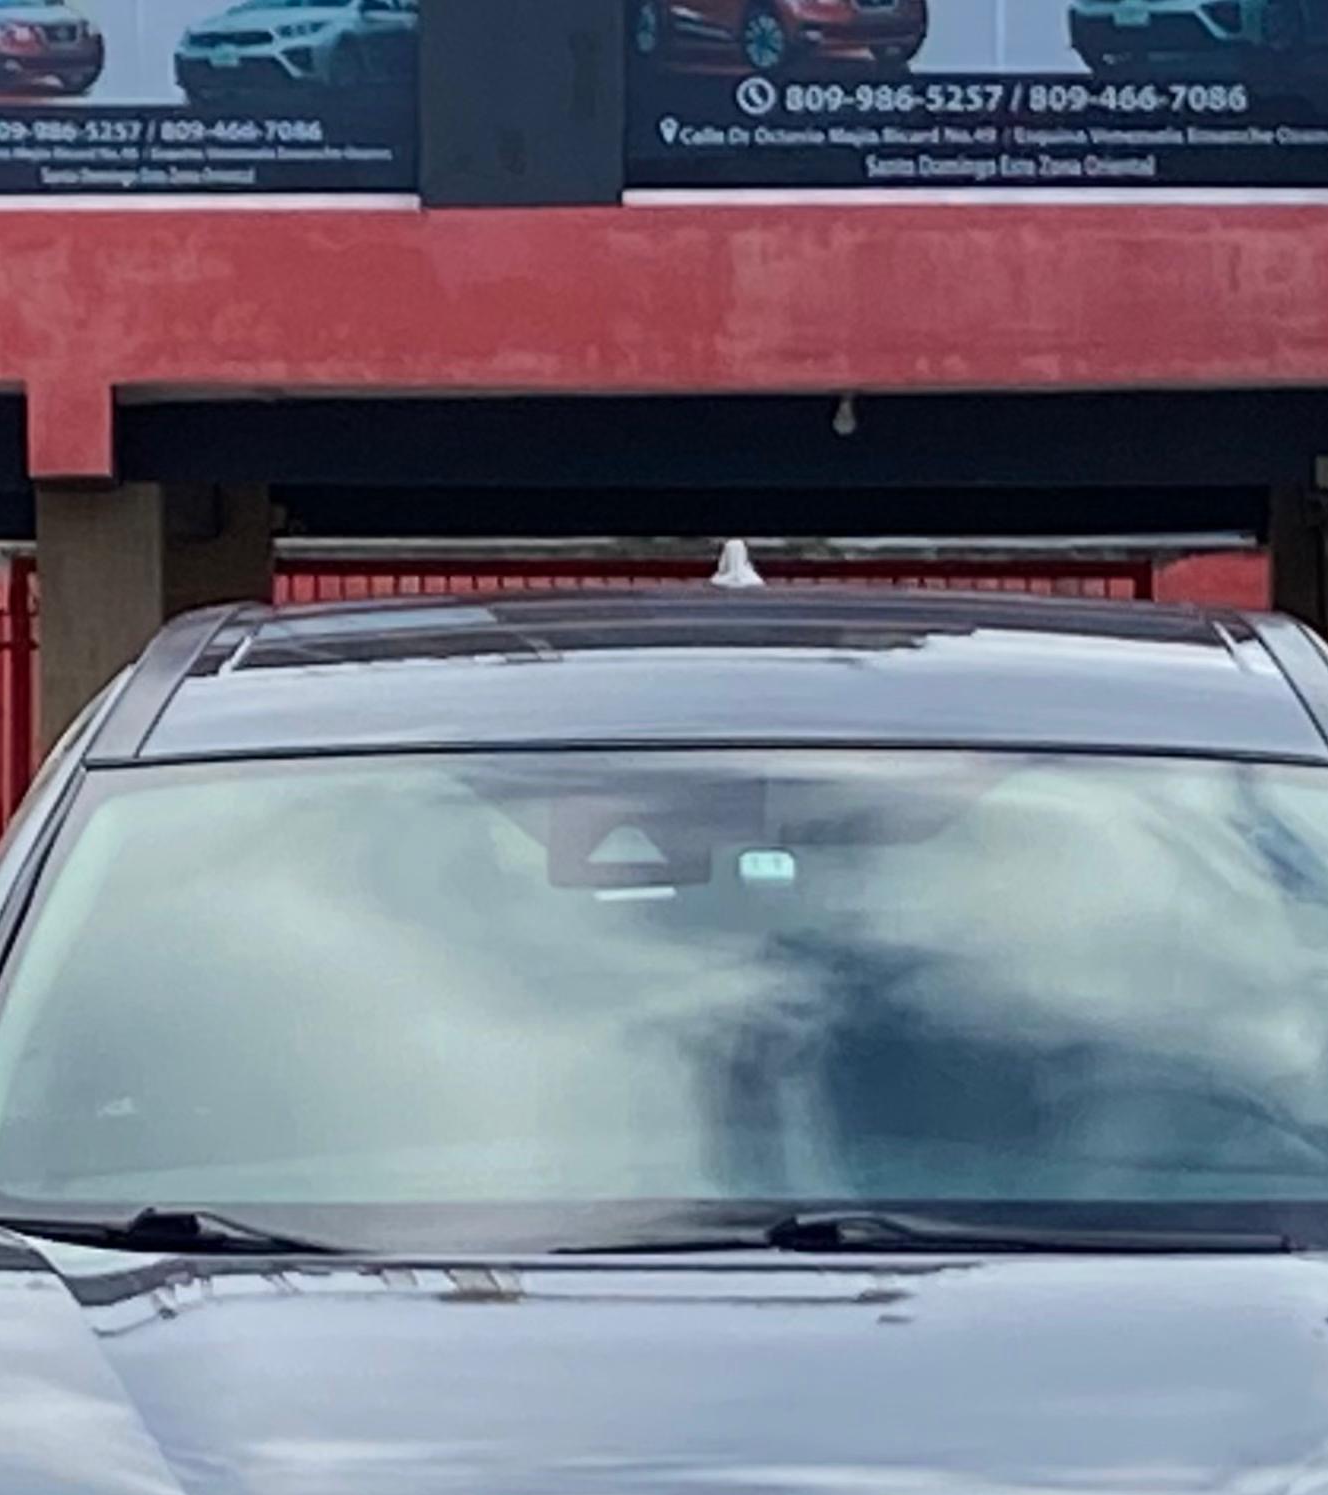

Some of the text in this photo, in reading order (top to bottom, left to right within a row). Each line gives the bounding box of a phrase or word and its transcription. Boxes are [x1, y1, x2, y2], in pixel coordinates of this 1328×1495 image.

[785, 85, 1004, 112] 809-986-5257
[1029, 84, 1248, 112] 809-466-7086
[160, 119, 323, 142] 809-466-7086
